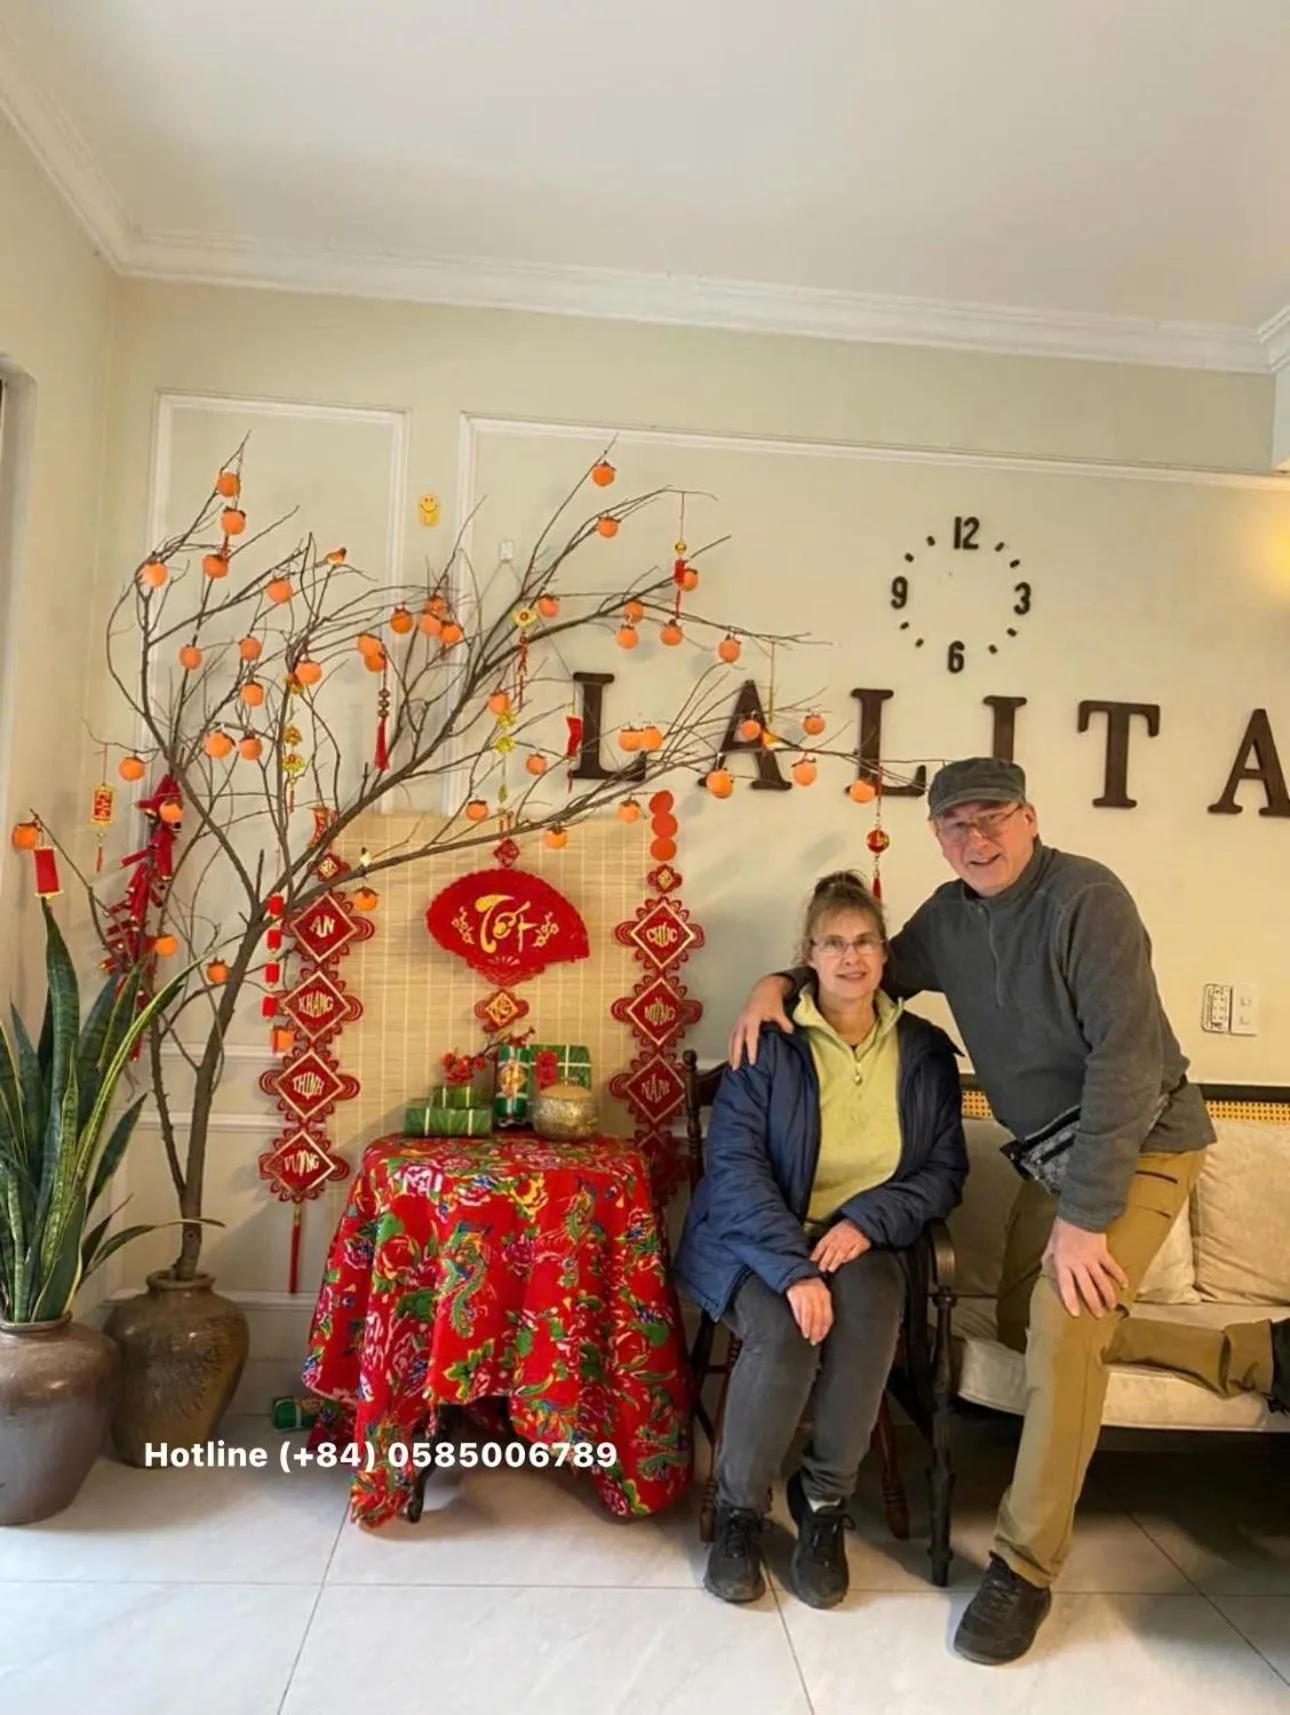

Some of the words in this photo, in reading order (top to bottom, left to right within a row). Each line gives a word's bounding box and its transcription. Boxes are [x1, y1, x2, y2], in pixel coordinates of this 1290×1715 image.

[953, 516, 980, 551] 12
[891, 576, 909, 610] 9
[1014, 582, 1032, 616] 3
[947, 640, 966, 674] 6
[309, 915, 335, 938] AN
[298, 990, 335, 1019] KHANG
